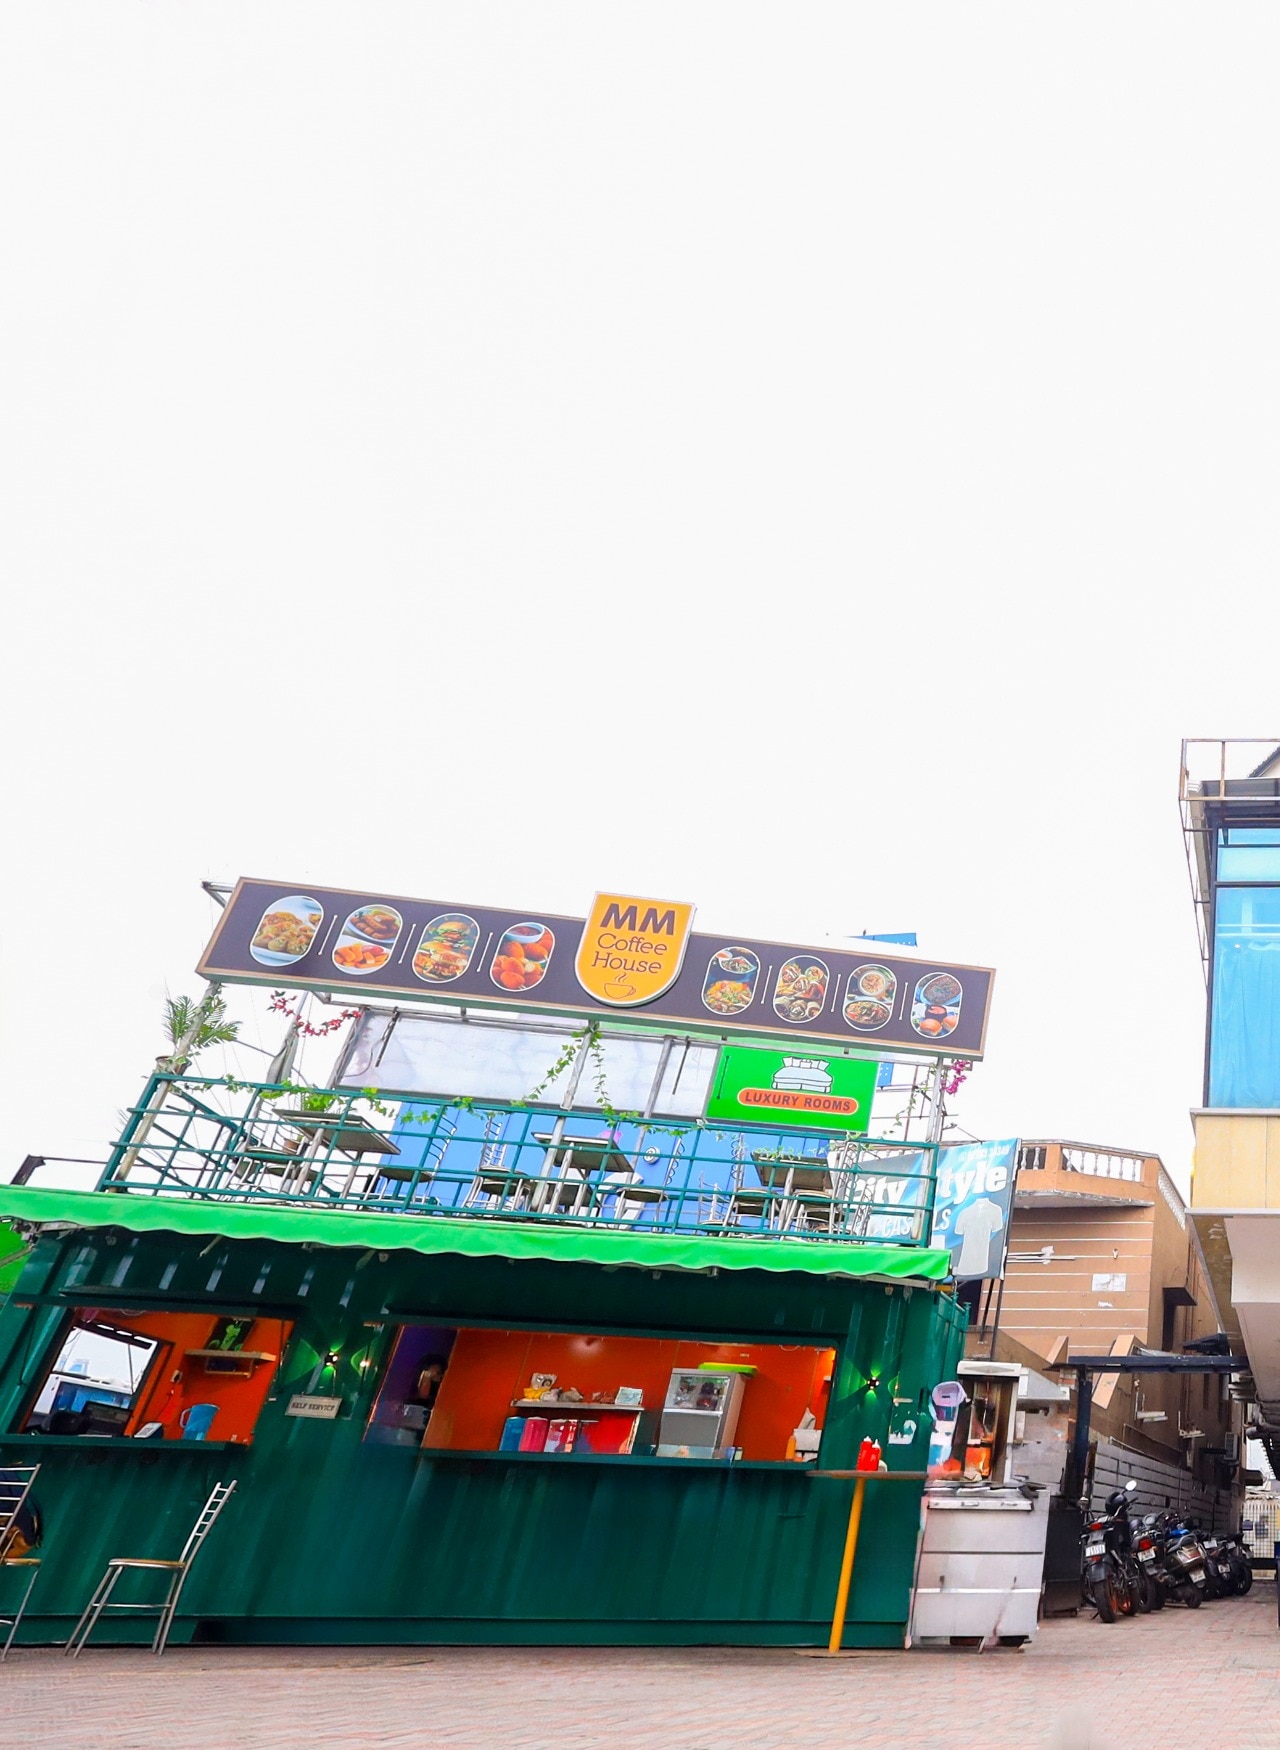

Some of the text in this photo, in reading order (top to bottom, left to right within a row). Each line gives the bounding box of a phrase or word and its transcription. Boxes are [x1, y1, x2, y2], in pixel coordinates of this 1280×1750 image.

[600, 903, 676, 936] MM
[597, 932, 668, 956] Coffee
[591, 950, 662, 974] House
[745, 1091, 852, 1112] LUXURY ROOMS
